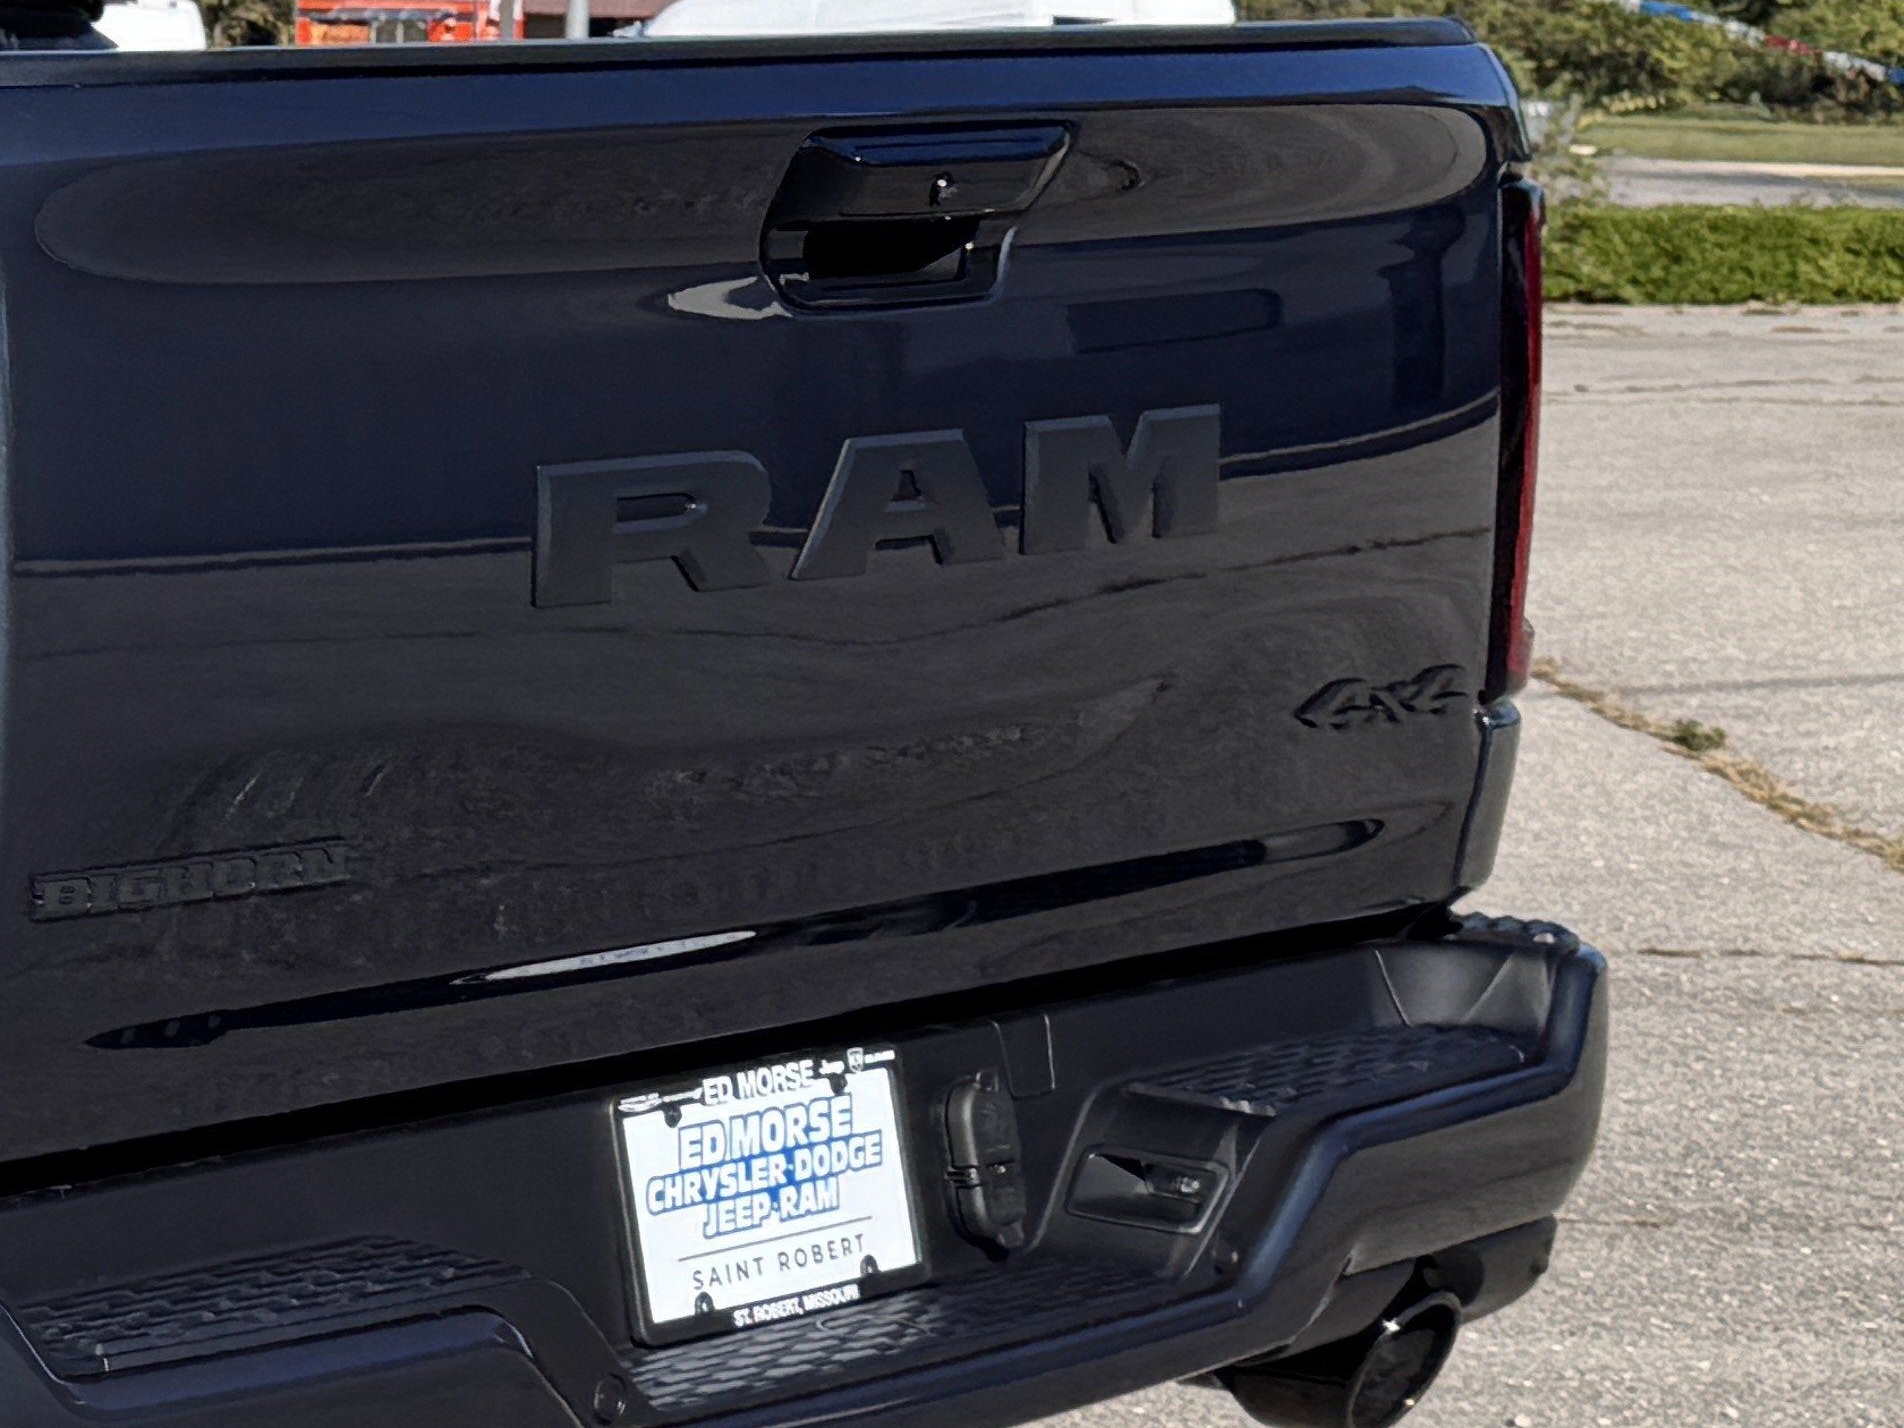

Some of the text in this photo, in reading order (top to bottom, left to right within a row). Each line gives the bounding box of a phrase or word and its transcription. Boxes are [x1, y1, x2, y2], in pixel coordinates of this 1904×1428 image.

[531, 402, 1221, 608] RAM
[702, 1075, 733, 1105] ED
[737, 1058, 814, 1100] MORSE
[678, 1095, 853, 1172] ED MORSE
[692, 1232, 865, 1291] SAINT ROBERT
[802, 1283, 861, 1311] MISSOURI
